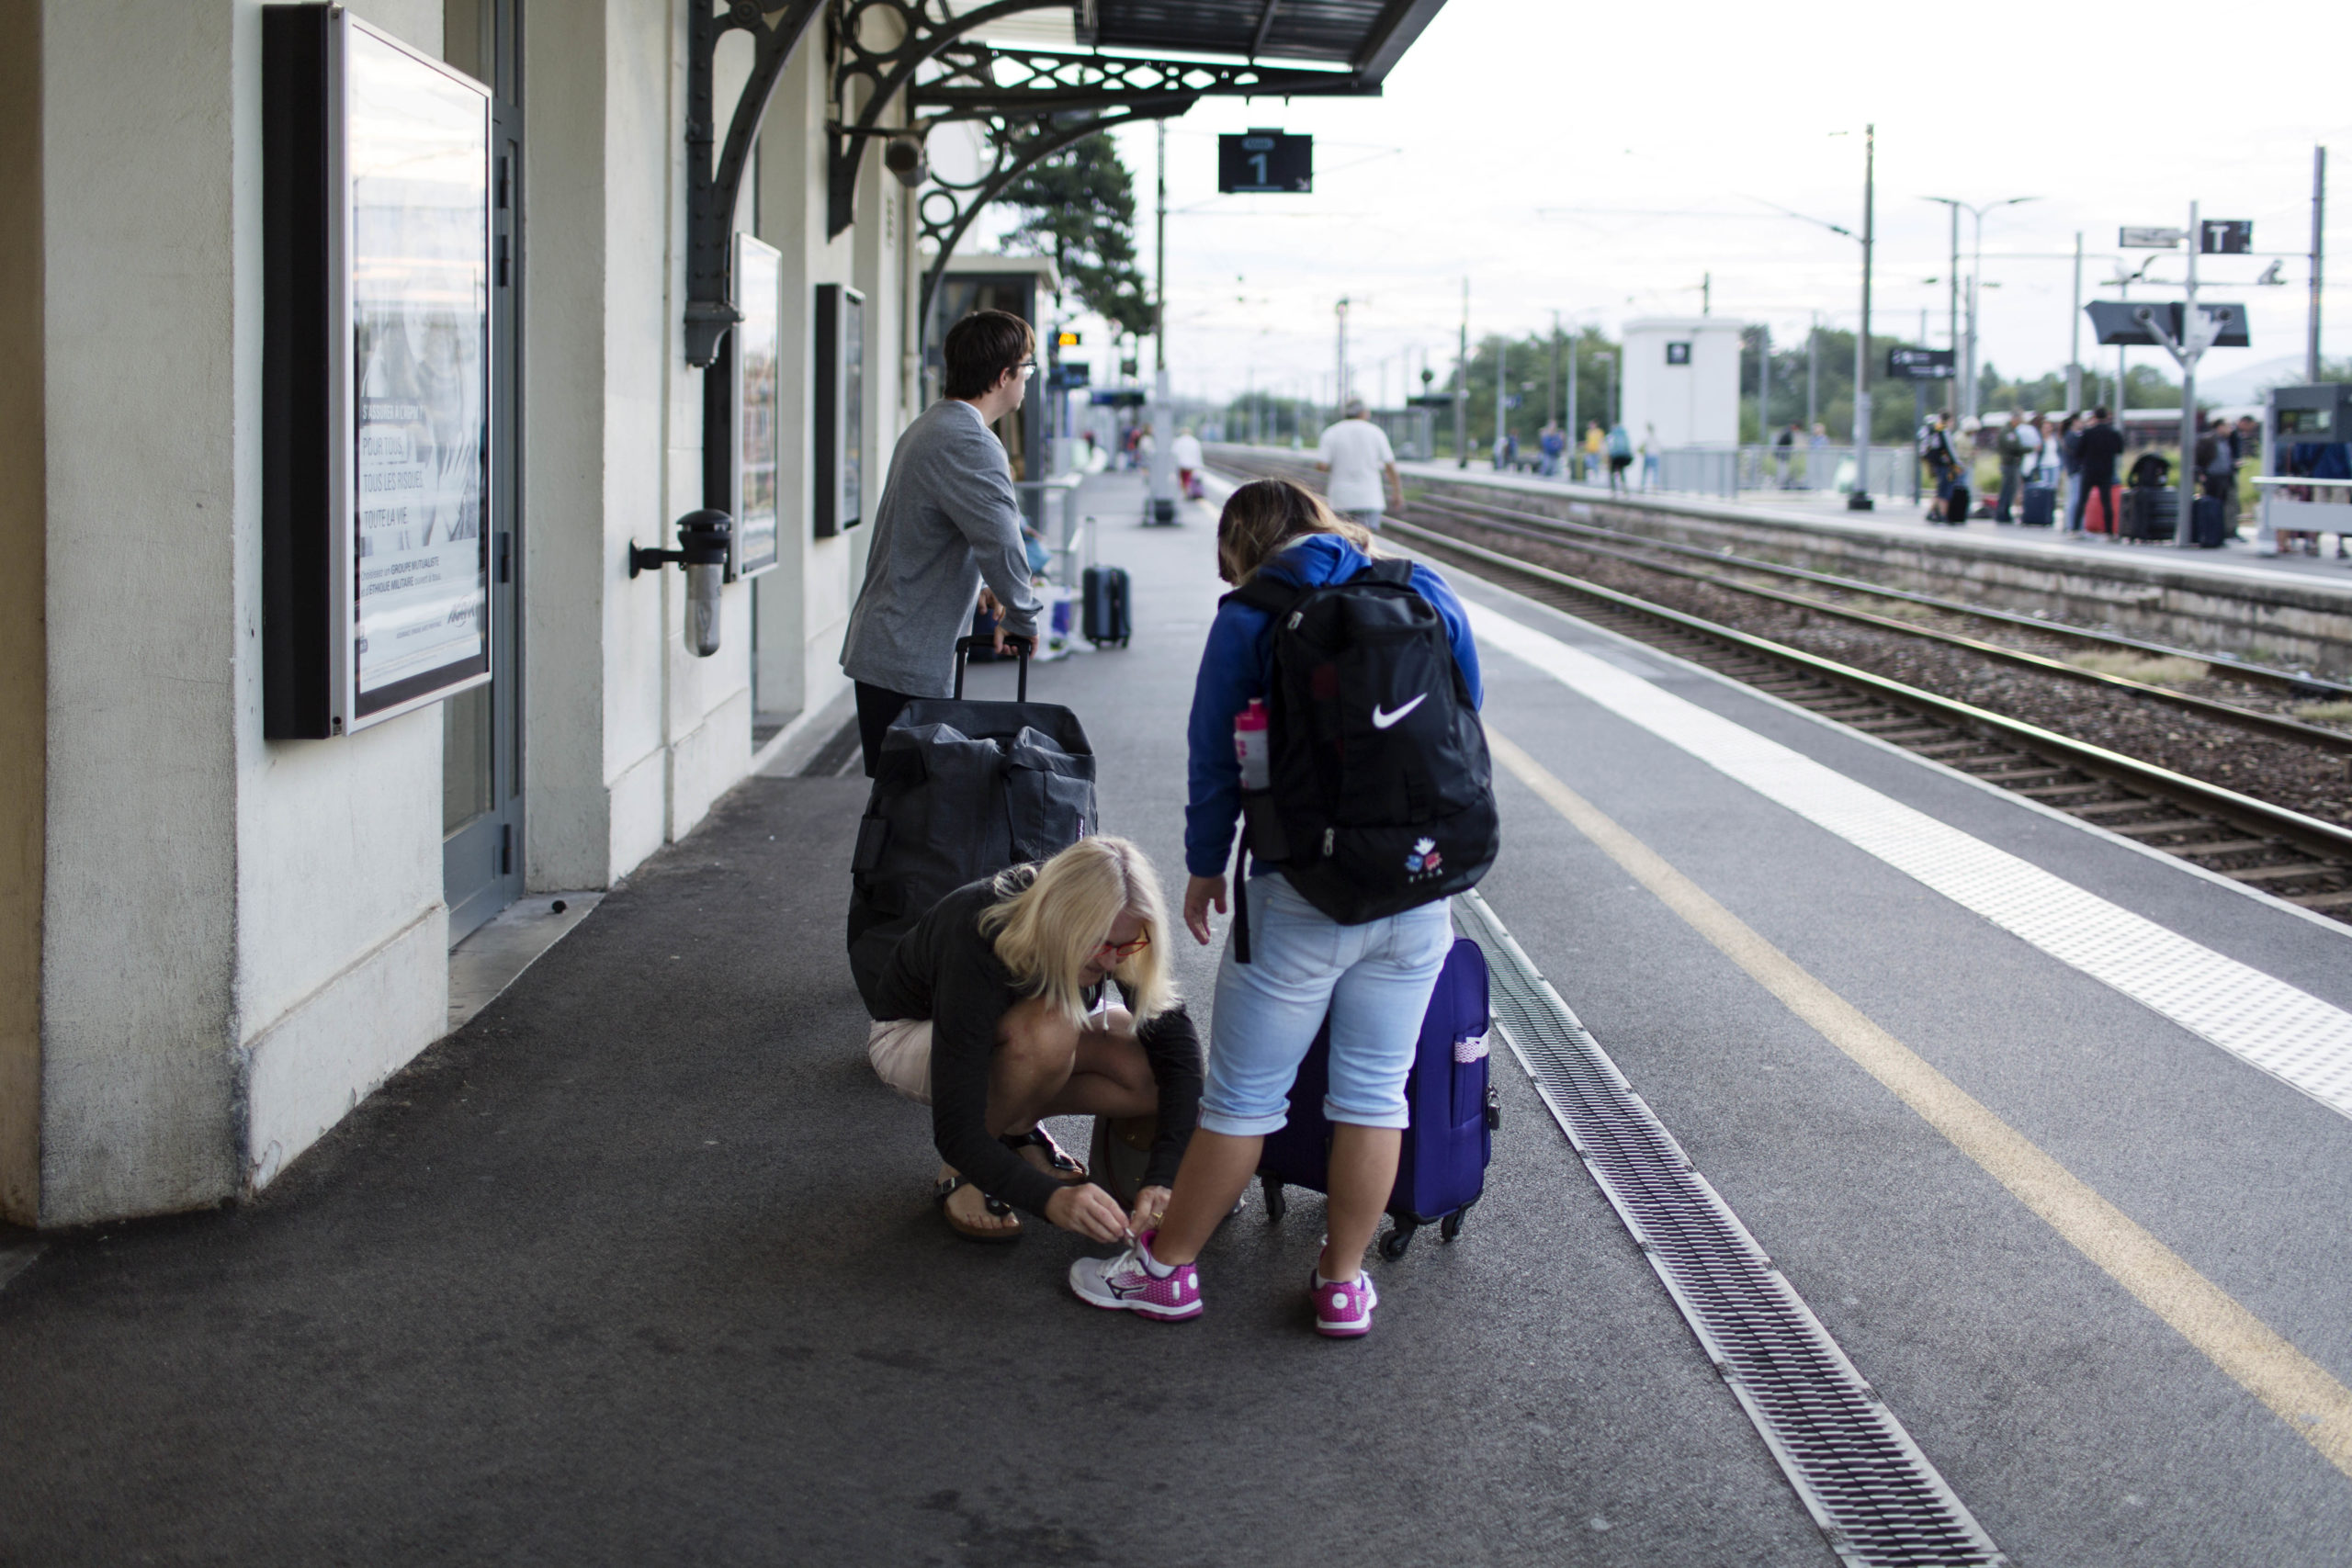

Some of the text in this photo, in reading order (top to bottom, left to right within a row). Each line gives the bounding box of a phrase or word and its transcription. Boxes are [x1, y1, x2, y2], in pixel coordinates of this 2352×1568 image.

[1247, 152, 1268, 186] 1
[2207, 225, 2231, 253] T
[363, 436, 382, 456] POUR
[363, 473, 382, 492] TOUS
[384, 472, 397, 491] LES
[364, 509, 386, 529] TOUTE
[386, 508, 396, 527] LA
[391, 561, 411, 575] GROUPE
